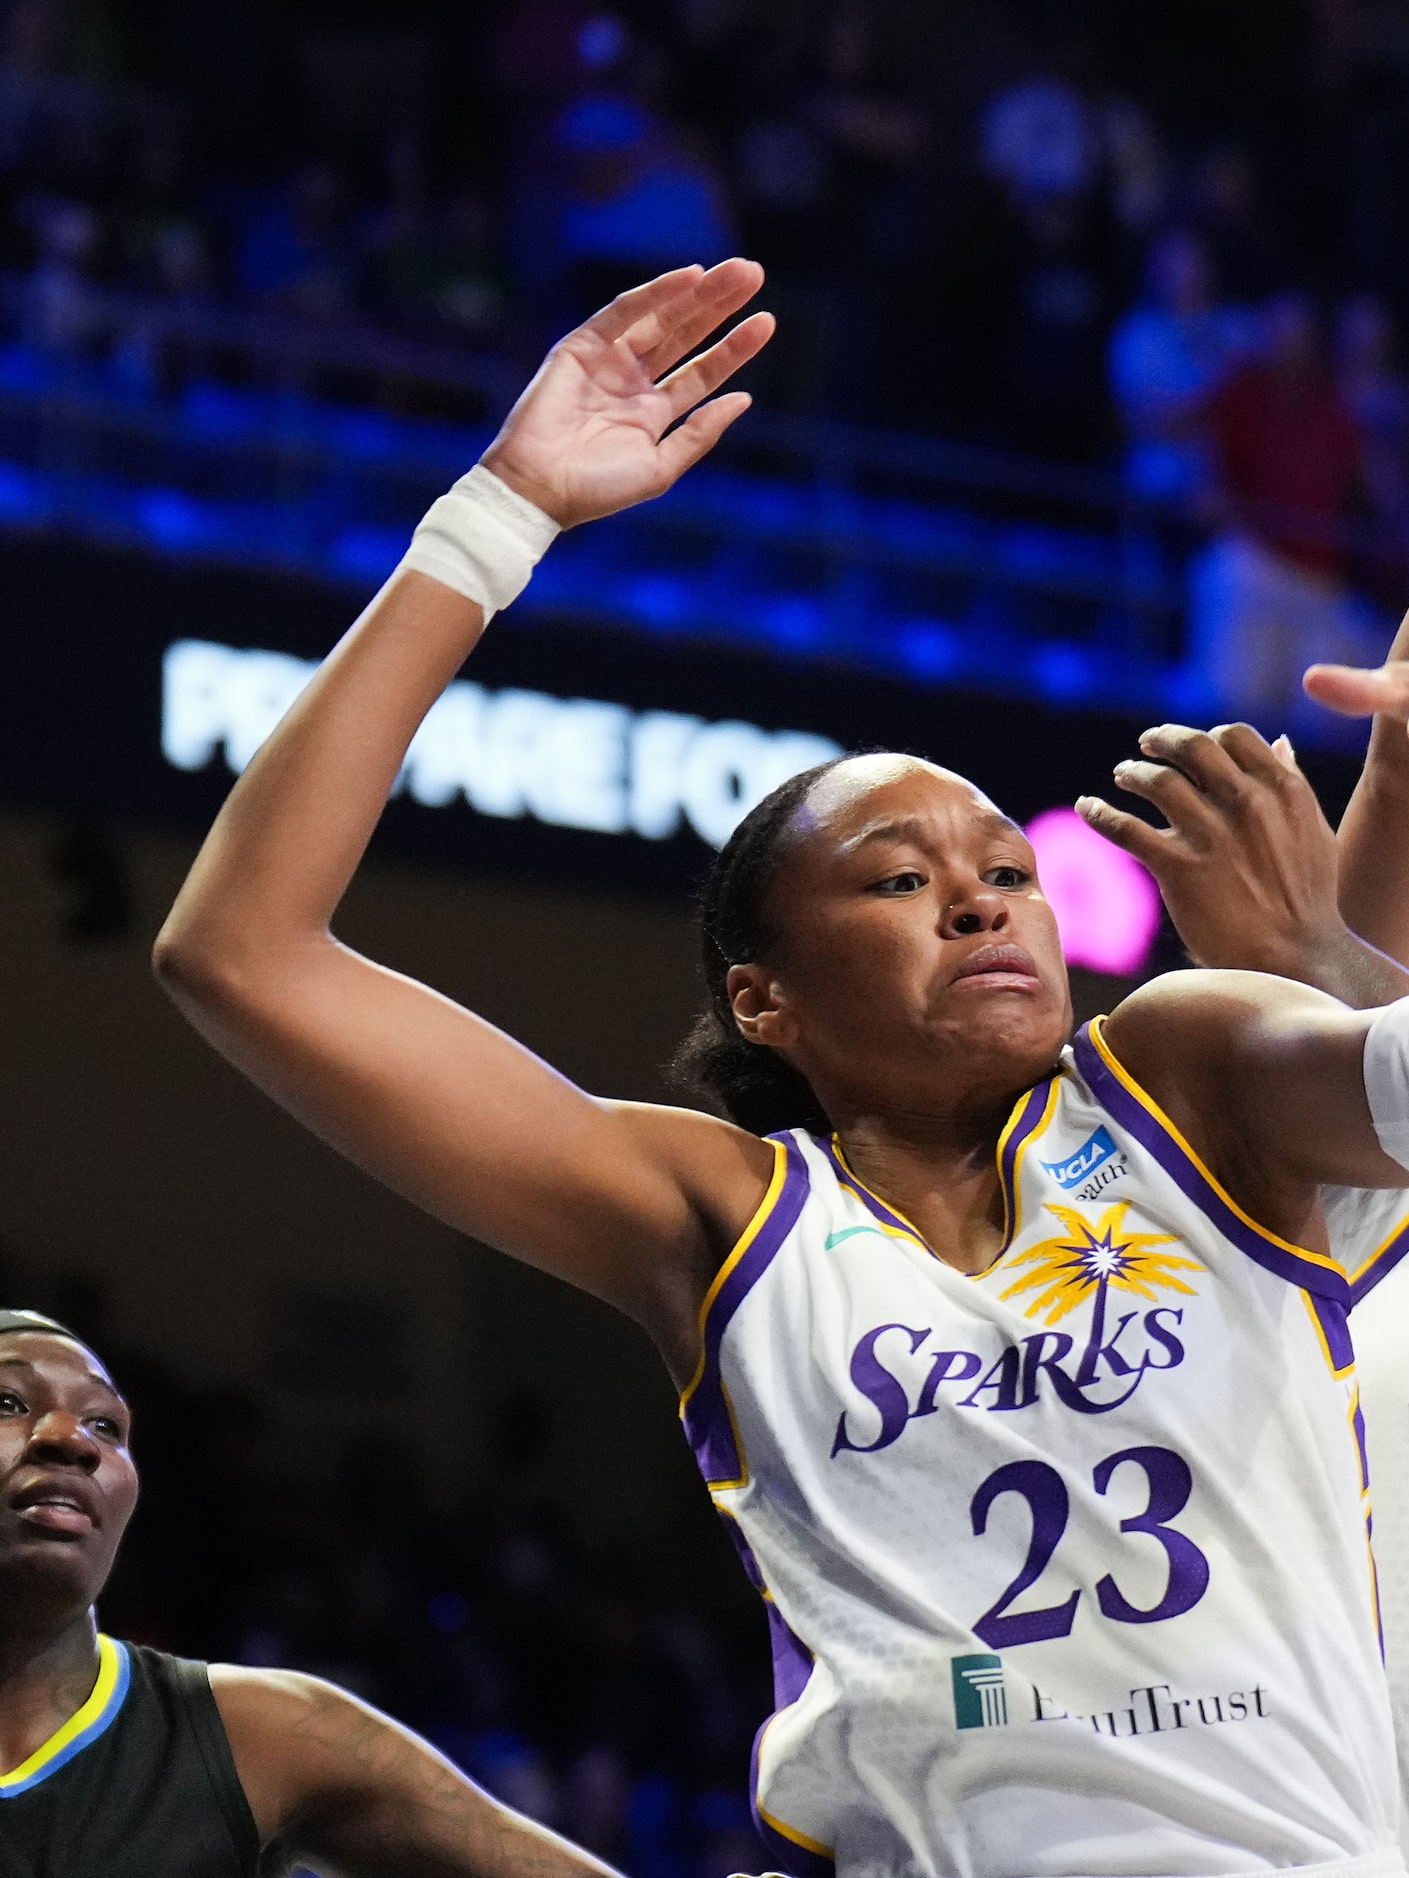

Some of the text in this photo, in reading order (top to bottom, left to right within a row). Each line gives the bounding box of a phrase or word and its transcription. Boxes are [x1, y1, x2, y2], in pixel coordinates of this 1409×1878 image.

[1048, 1142, 1105, 1184] UCLA
[830, 1307, 1186, 1459] SPARKS
[970, 1446, 1209, 1650] 23
